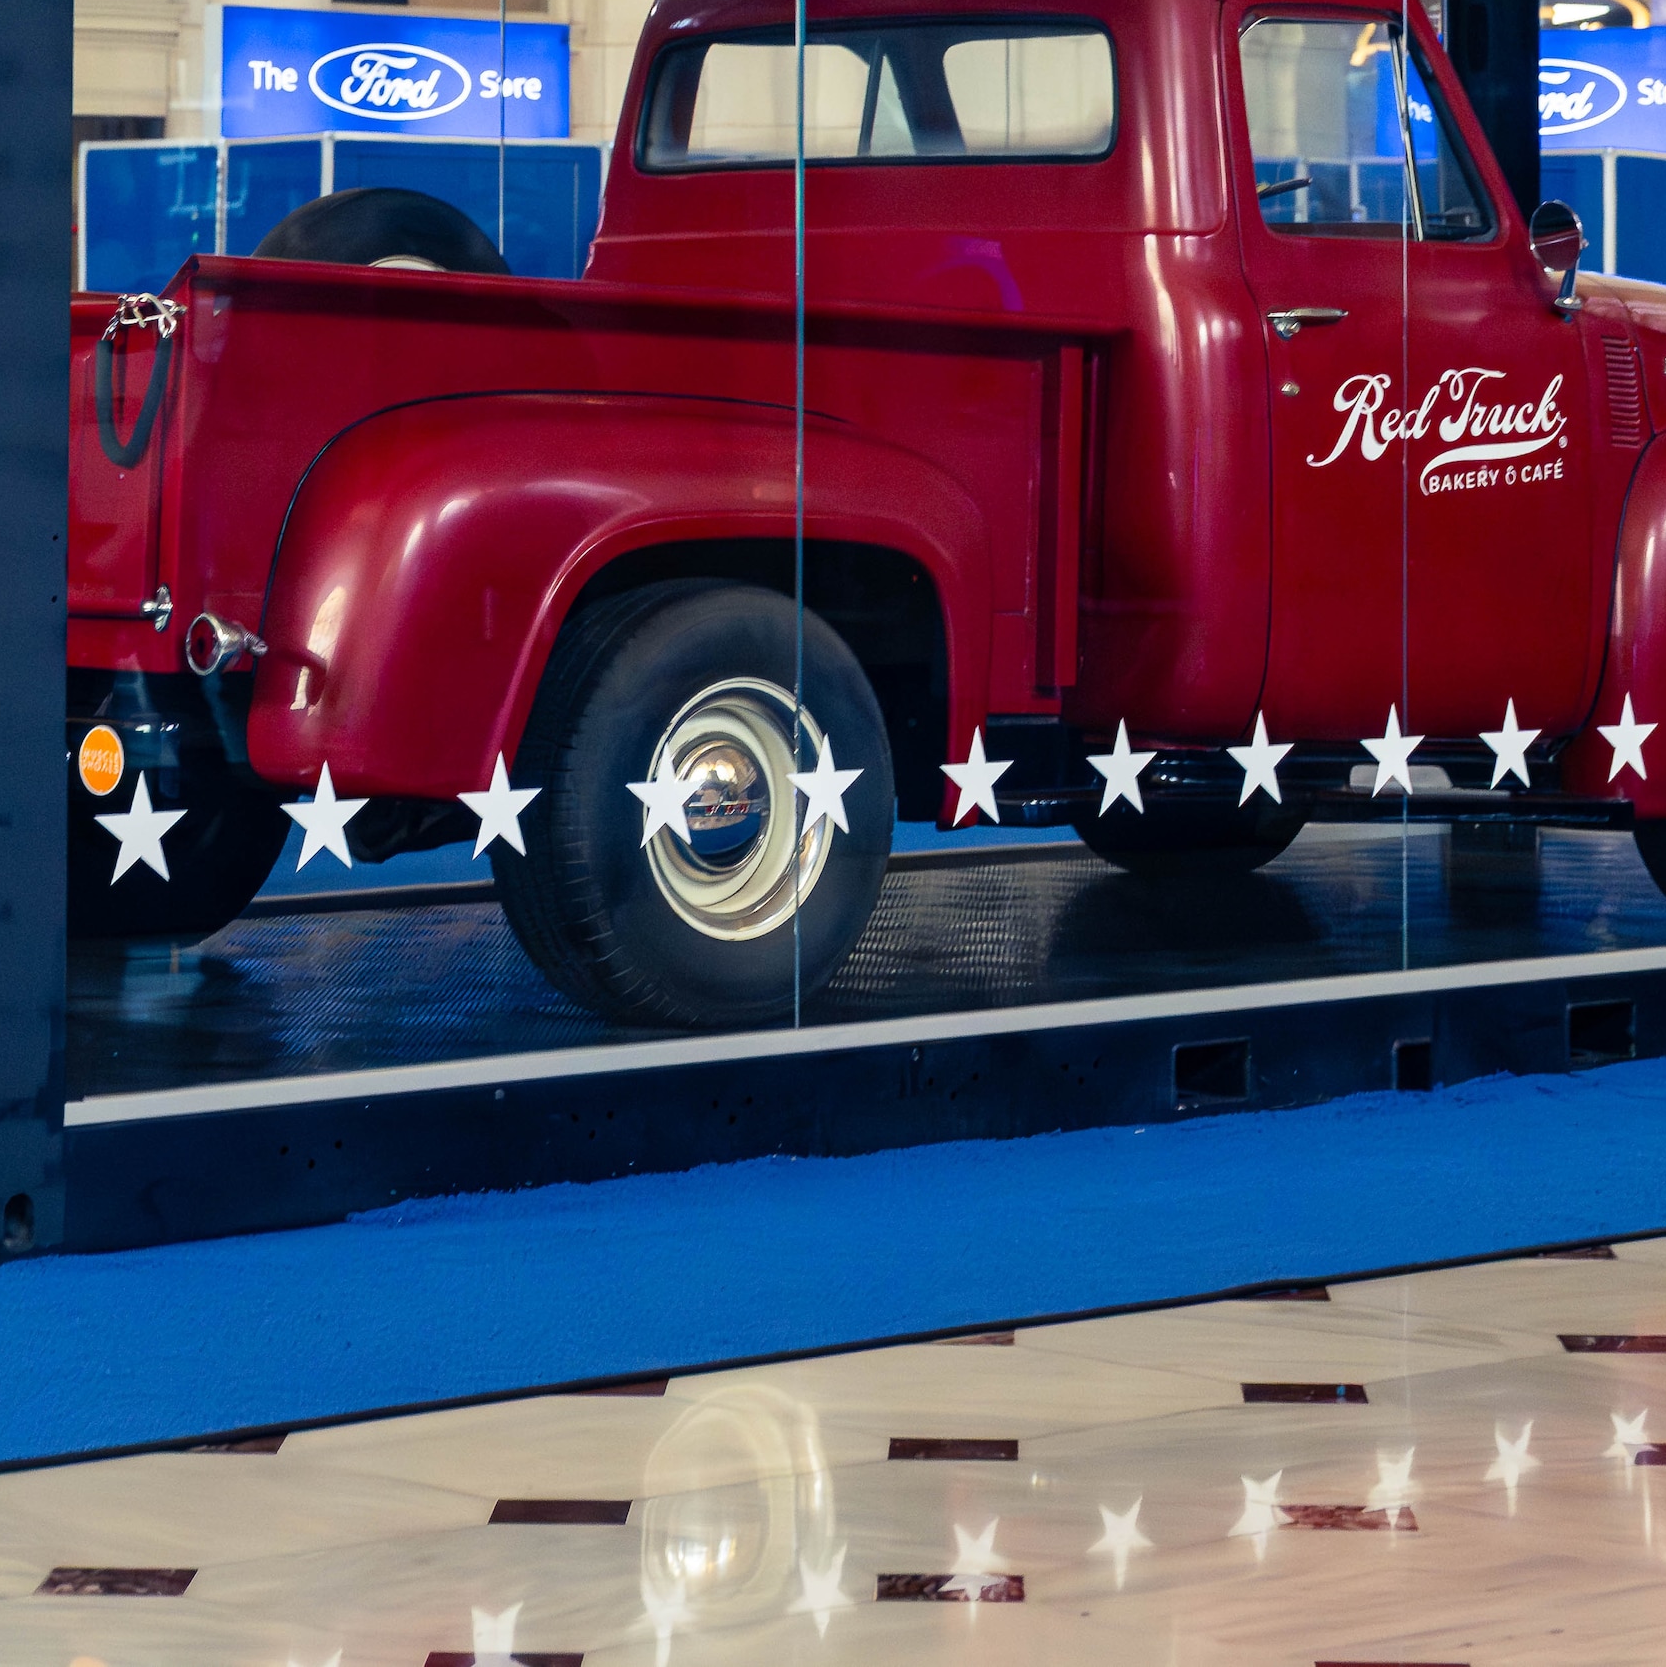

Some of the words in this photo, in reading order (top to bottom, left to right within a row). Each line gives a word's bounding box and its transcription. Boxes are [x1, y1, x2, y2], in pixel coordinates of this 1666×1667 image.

[248, 60, 299, 93] The
[340, 51, 442, 110] Ford
[1407, 95, 1434, 124] he
[1305, 373, 1441, 468] Red
[1438, 366, 1568, 444] Truck
[1428, 467, 1500, 494] BAKERY
[1520, 457, 1565, 484] CAFÉ
